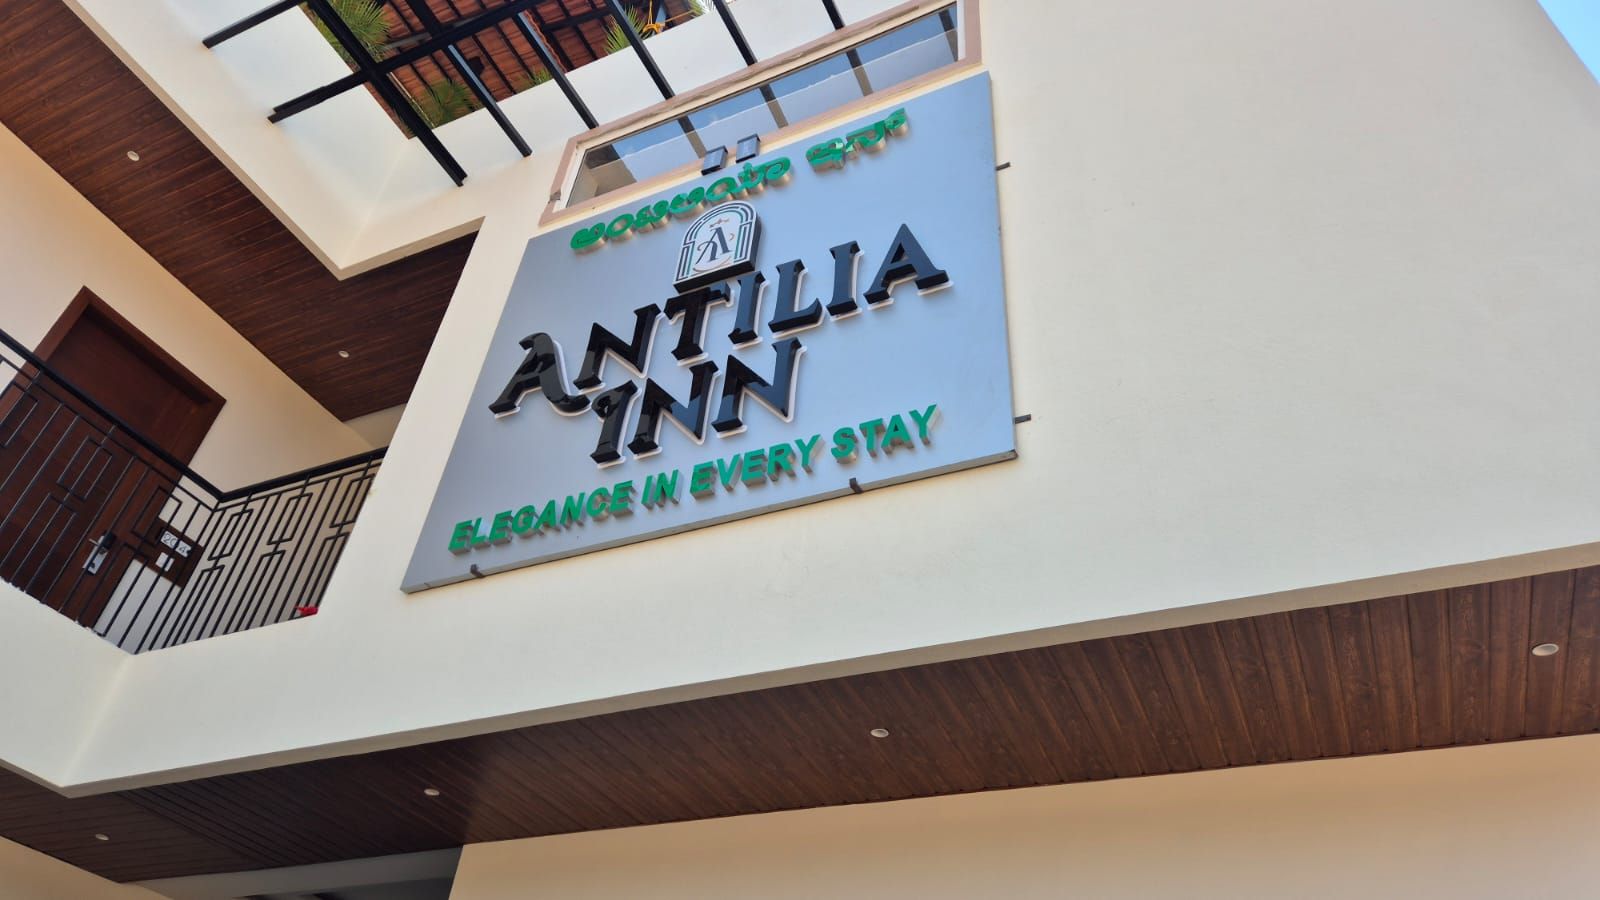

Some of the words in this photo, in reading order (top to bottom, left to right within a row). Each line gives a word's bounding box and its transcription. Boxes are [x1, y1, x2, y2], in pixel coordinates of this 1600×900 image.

[489, 223, 949, 414] ANTILIA
[591, 337, 804, 464] INN
[449, 480, 635, 552] ELEGANCE
[641, 469, 680, 506] IN
[690, 434, 822, 495] EVERY
[831, 404, 938, 461] STAY
